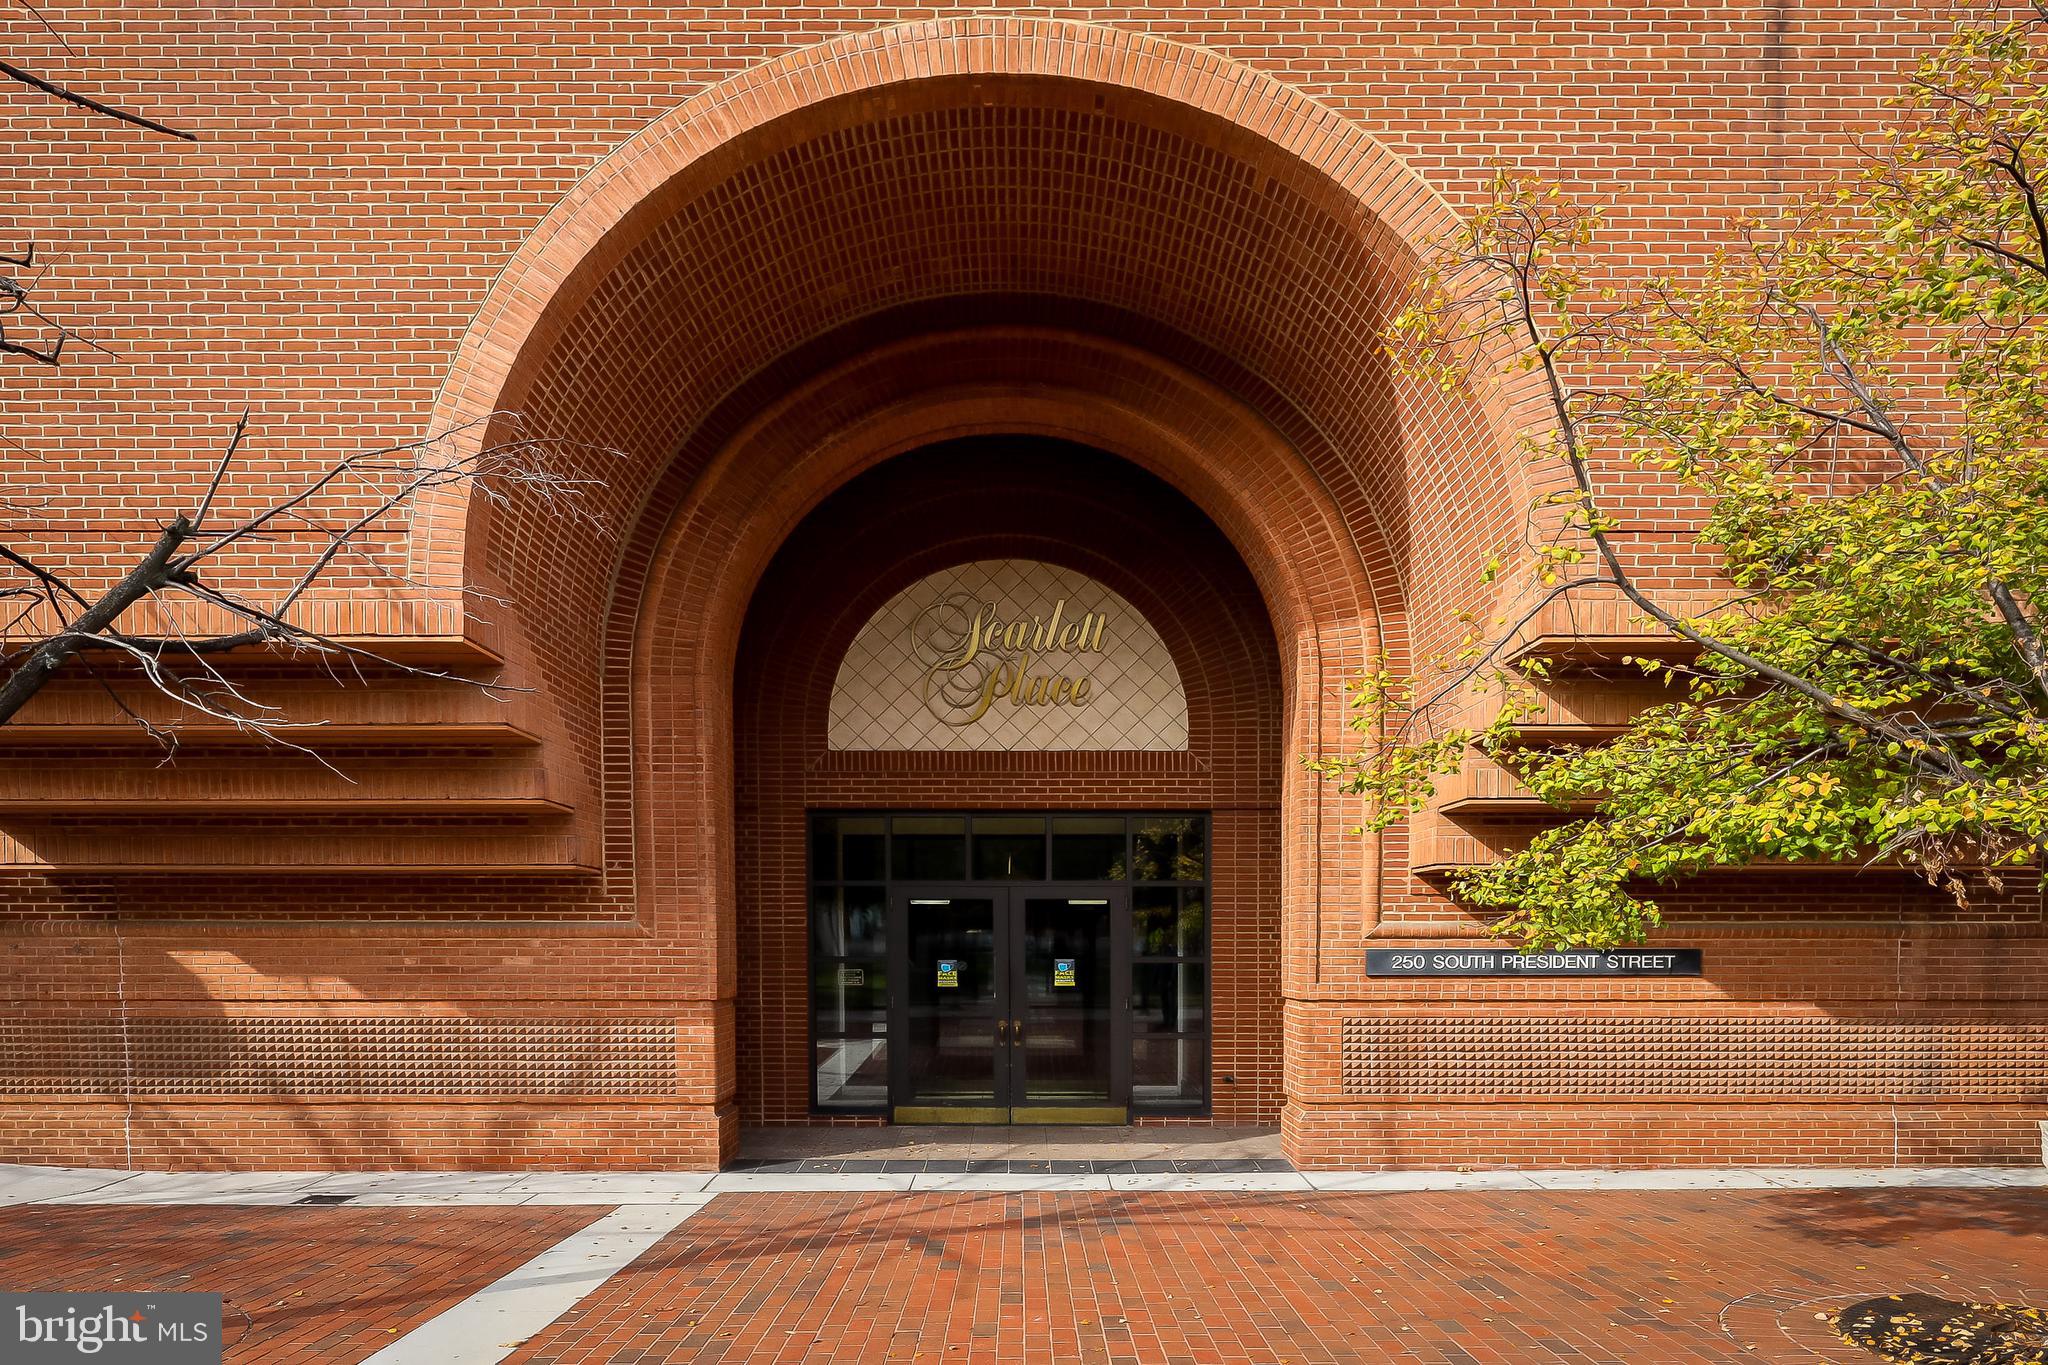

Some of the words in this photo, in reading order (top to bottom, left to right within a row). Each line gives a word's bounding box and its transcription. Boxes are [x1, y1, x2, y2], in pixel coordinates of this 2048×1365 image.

[911, 592, 1108, 669] Scarlett
[923, 651, 1091, 726] Place
[1391, 954, 1425, 969] 250
[1433, 954, 1494, 969] SOUTH
[1501, 954, 1600, 969] PRESIDENT
[1606, 954, 1676, 969] STREET
